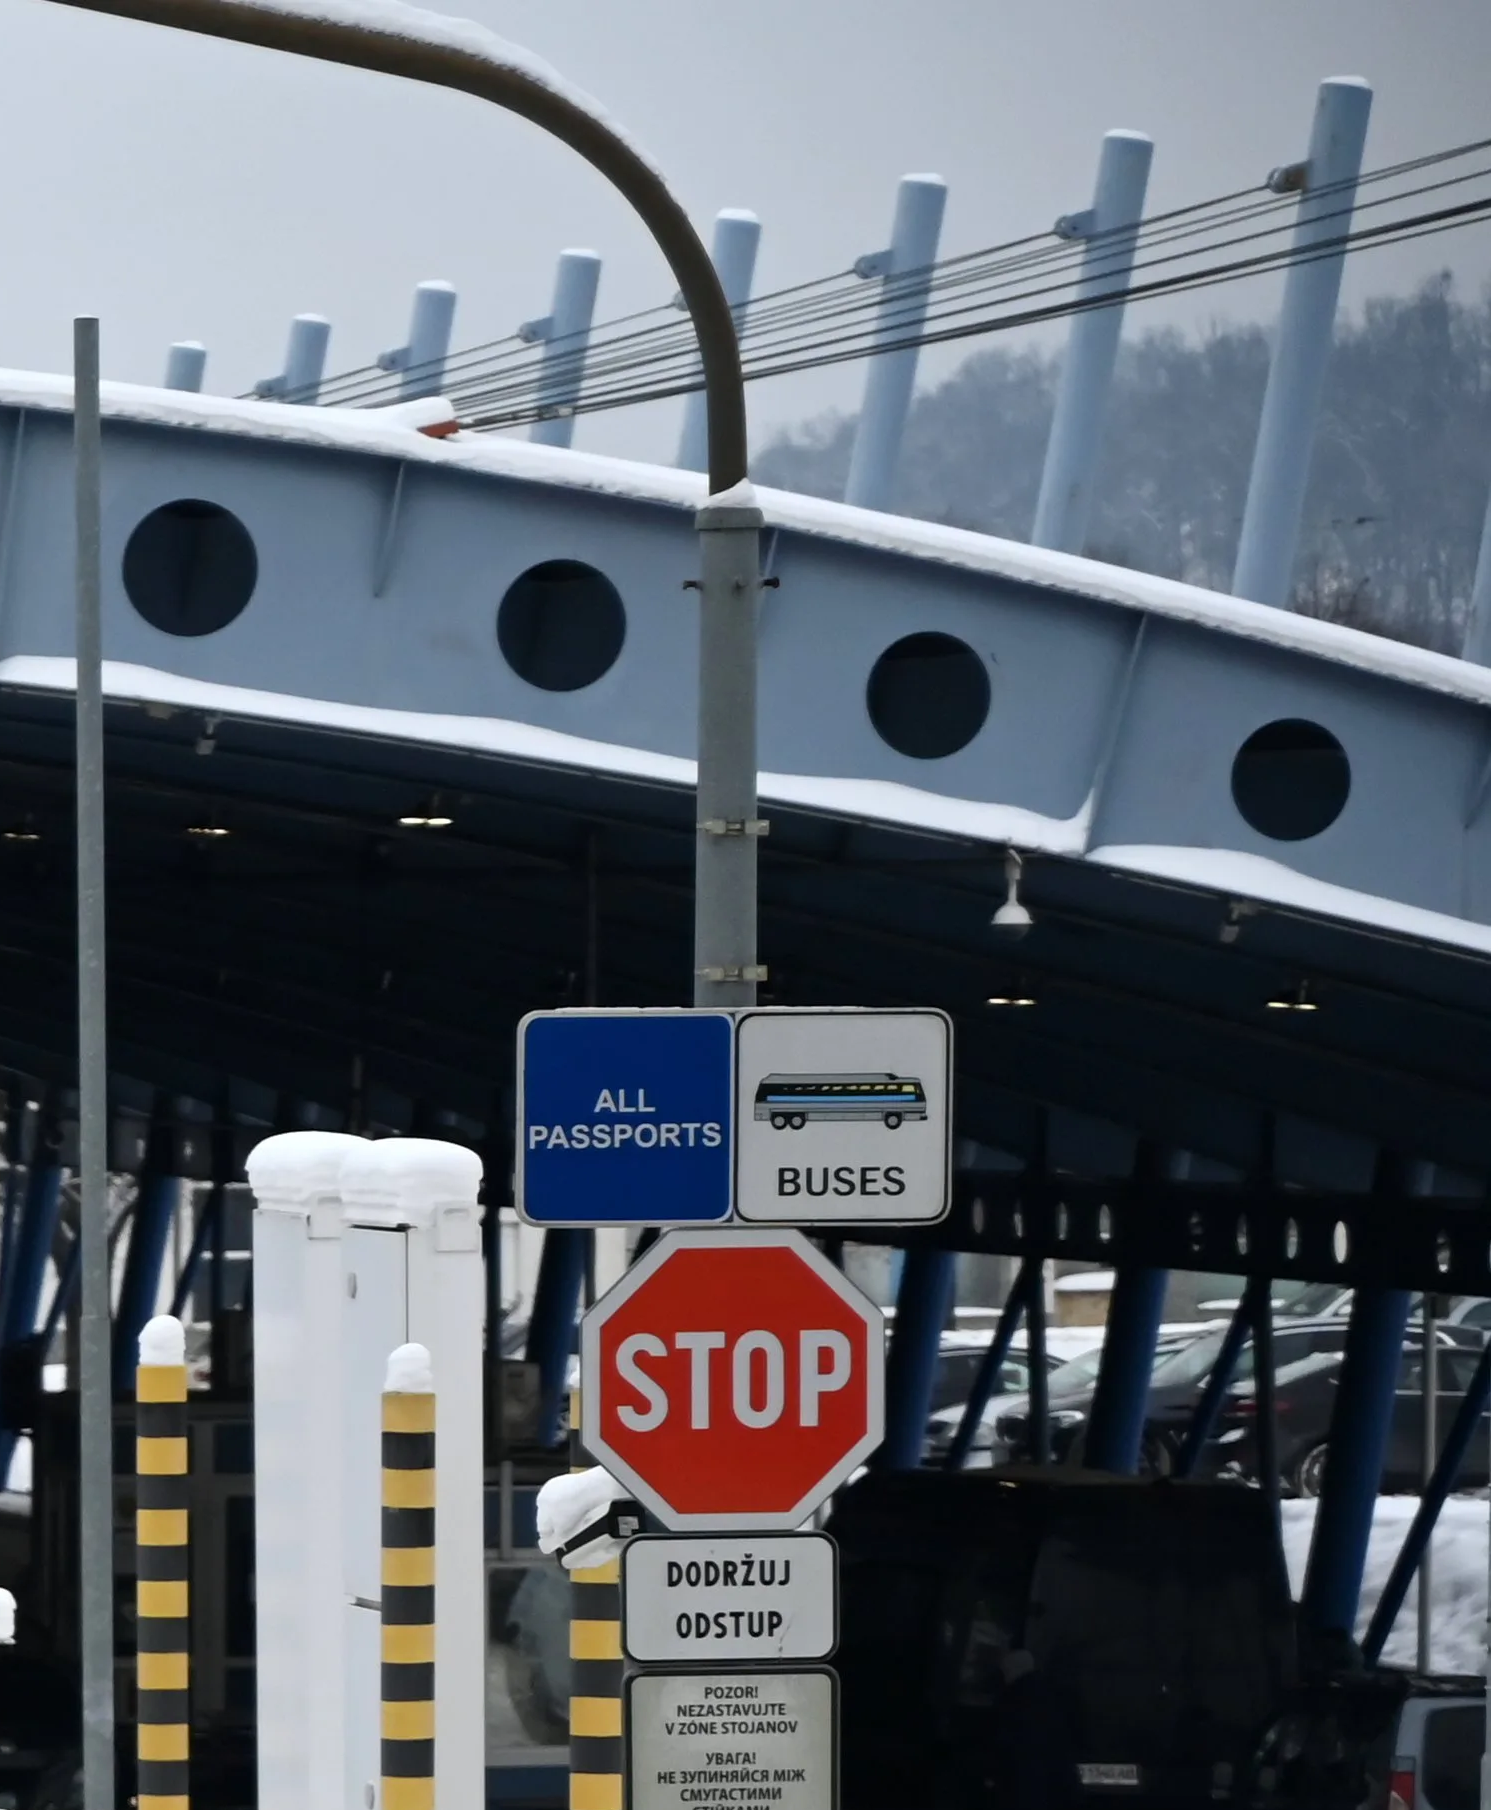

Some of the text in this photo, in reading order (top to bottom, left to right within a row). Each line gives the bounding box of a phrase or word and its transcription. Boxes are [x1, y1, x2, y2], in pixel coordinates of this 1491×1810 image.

[593, 1088, 656, 1114] ALL
[528, 1122, 723, 1150] PASSPORTS
[777, 1166, 907, 1197] BUSES
[615, 1329, 852, 1433] STOP
[666, 1553, 792, 1588] DODRŽUJ
[675, 1610, 784, 1640] ODSTUP
[704, 1686, 759, 1701] POZOR!
[676, 1703, 787, 1718] NEZASTAVUJTE
[665, 1718, 798, 1735] V ZÓNE STOJANOV
[705, 1752, 757, 1767] УВАГА!
[657, 1767, 806, 1784] НЕ ЗУПИНЯЙСЯ МІЖ
[680, 1787, 782, 1802] СМУГАСТИМИ
